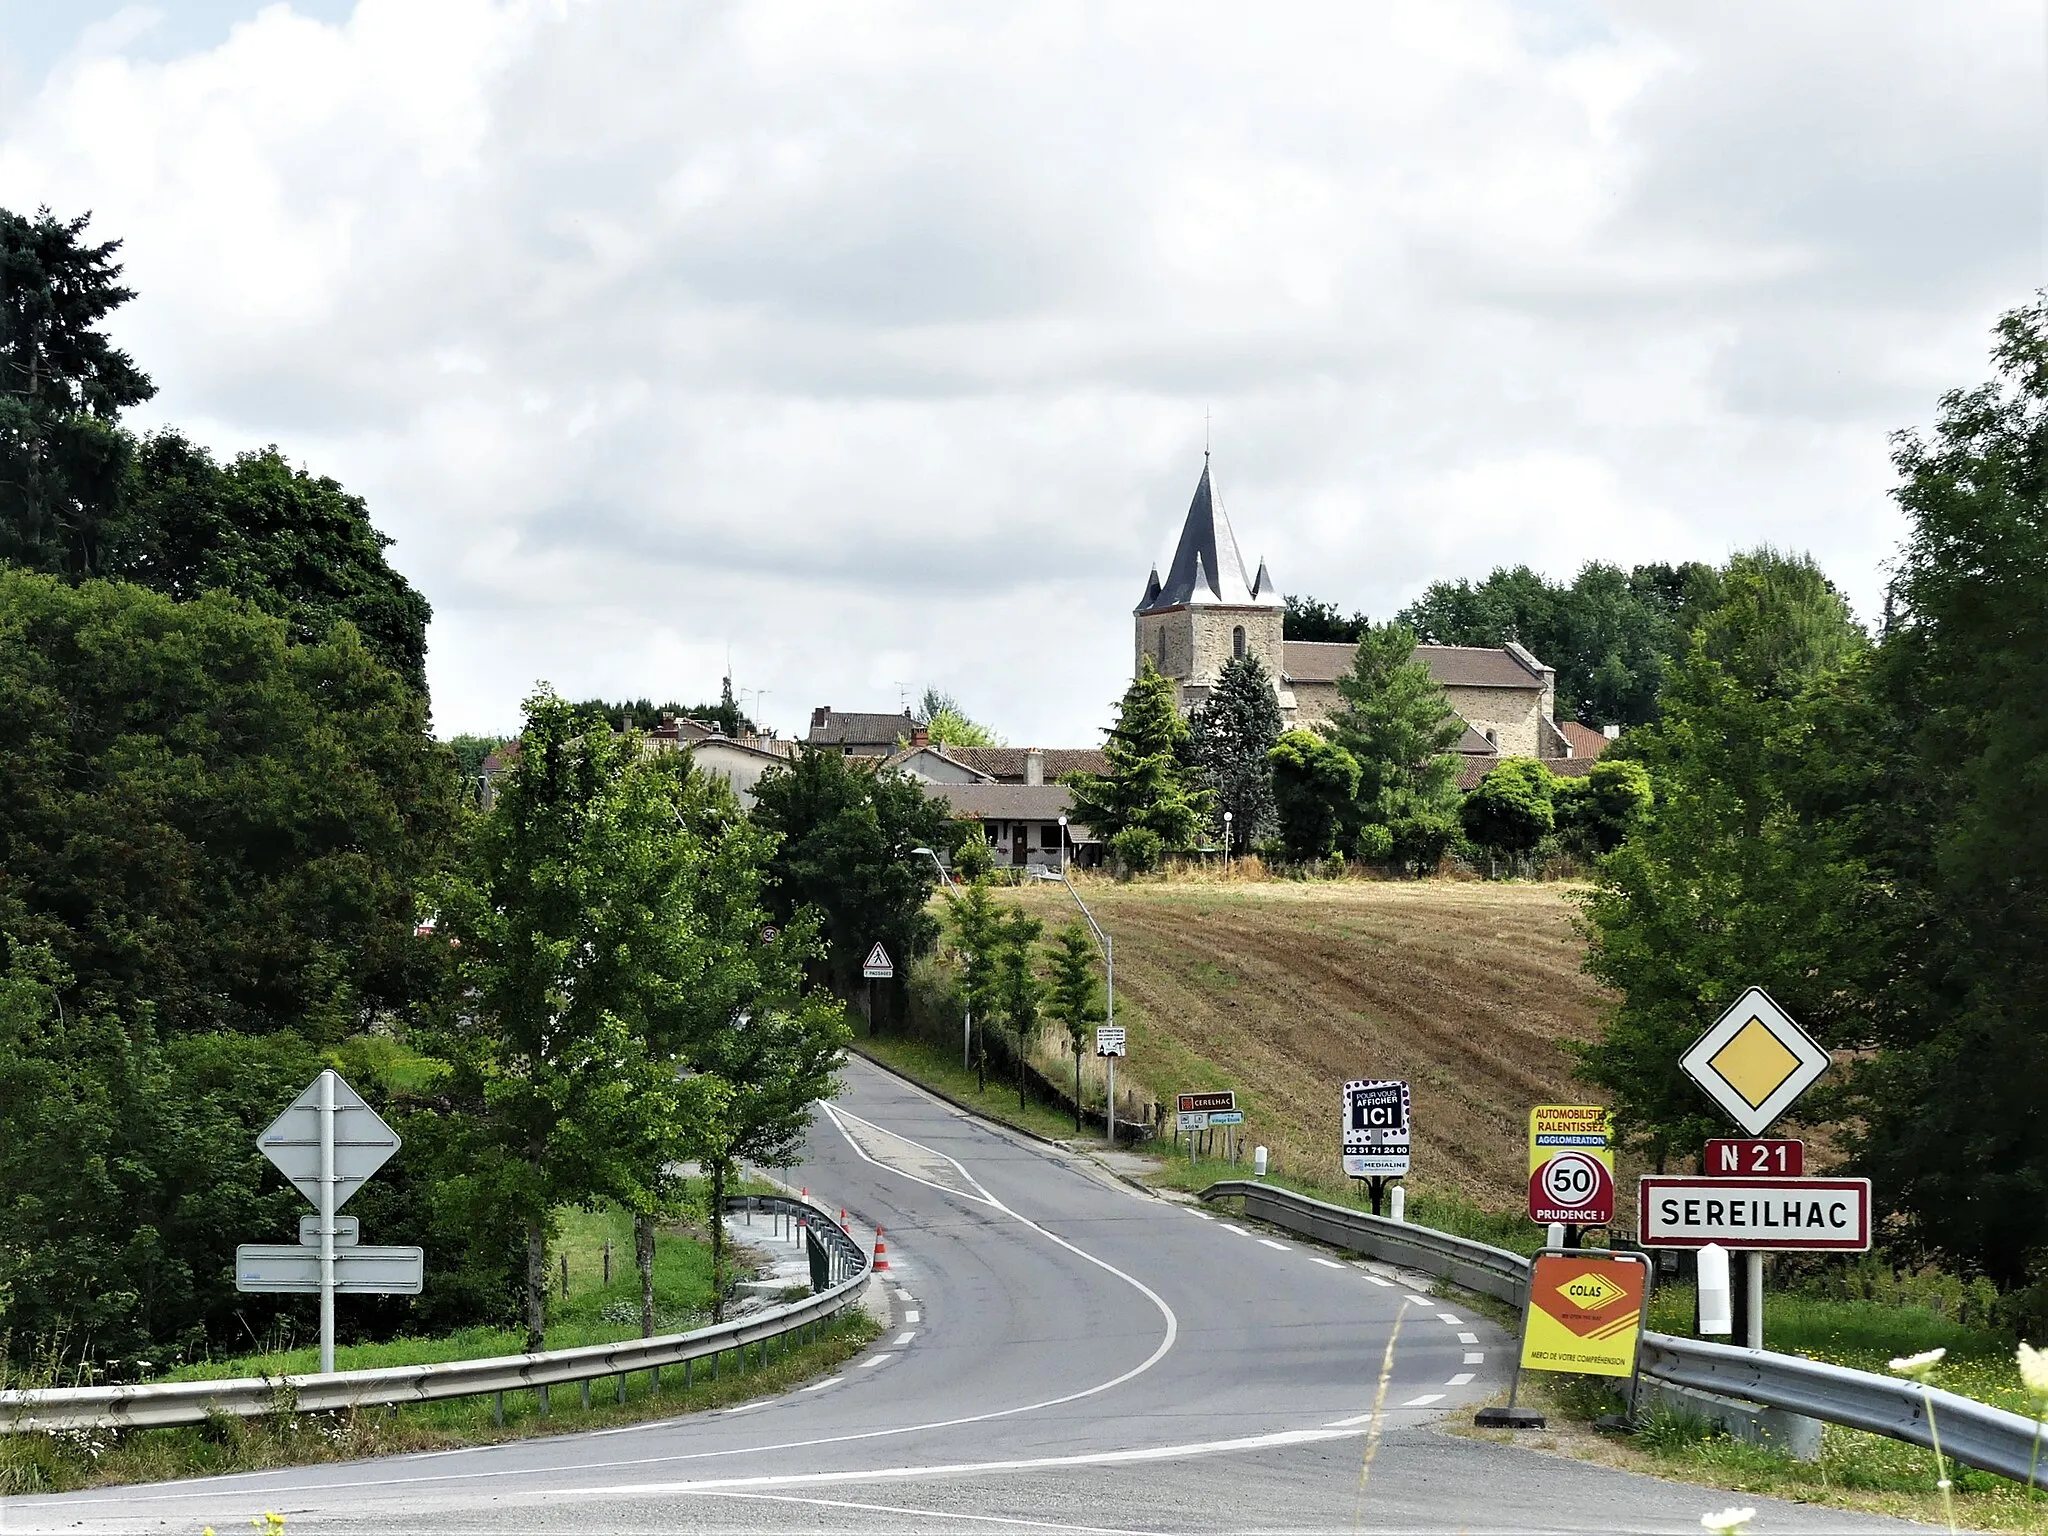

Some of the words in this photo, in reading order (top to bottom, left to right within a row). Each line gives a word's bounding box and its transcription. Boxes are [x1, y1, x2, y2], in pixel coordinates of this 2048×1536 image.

[765, 931, 775, 939] 50
[1356, 1092, 1376, 1100] POUR
[1194, 1098, 1231, 1107] CERELHAC
[1357, 1097, 1397, 1107] AFFICHER
[1363, 1108, 1392, 1125] ICI
[1538, 1122, 1605, 1132] RALENTISSEZ
[1537, 1136, 1605, 1144] AGGLOMERATION
[1721, 1145, 1738, 1171] N
[1751, 1145, 1786, 1172] 21
[1553, 1169, 1590, 1192] 50
[1536, 1210, 1597, 1220] PRUDENCE
[1661, 1199, 1847, 1228] SEREILHAC
[1569, 1285, 1602, 1297] COLAS
[1531, 1351, 1548, 1360] MERCI
[1549, 1352, 1557, 1360] DE
[1558, 1353, 1576, 1362] VOTRE
